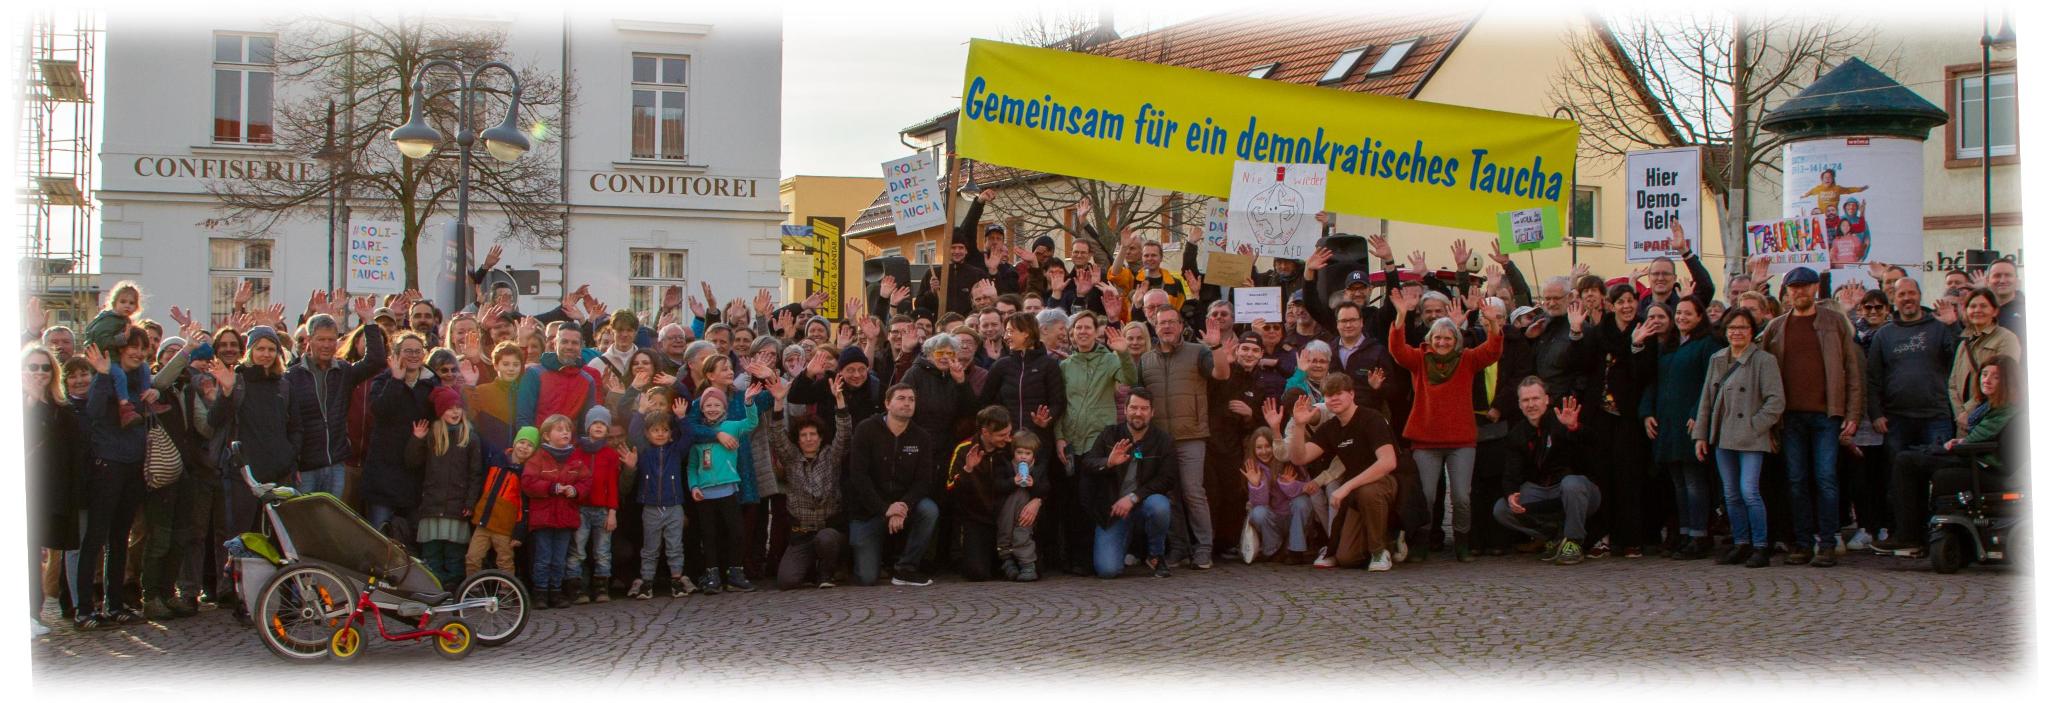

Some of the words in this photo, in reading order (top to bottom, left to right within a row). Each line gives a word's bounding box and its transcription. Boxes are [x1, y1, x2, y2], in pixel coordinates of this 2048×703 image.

[966, 76, 1124, 140] Gemeinsam
[1134, 103, 1178, 148] für
[1186, 117, 1228, 155] ein
[1237, 116, 1459, 187] demokratisches
[1470, 149, 1563, 202] Taucha
[134, 156, 315, 182] CONFISERIE
[1646, 168, 1678, 187] Hier
[589, 173, 757, 198] CONDITOREI
[893, 189, 929, 205] SCHES
[1637, 190, 1688, 209] Demo-
[896, 201, 940, 218] TAUCHA
[352, 240, 389, 251] DARI-
[352, 254, 389, 265] SCHES
[352, 269, 395, 281] TAUCHA
